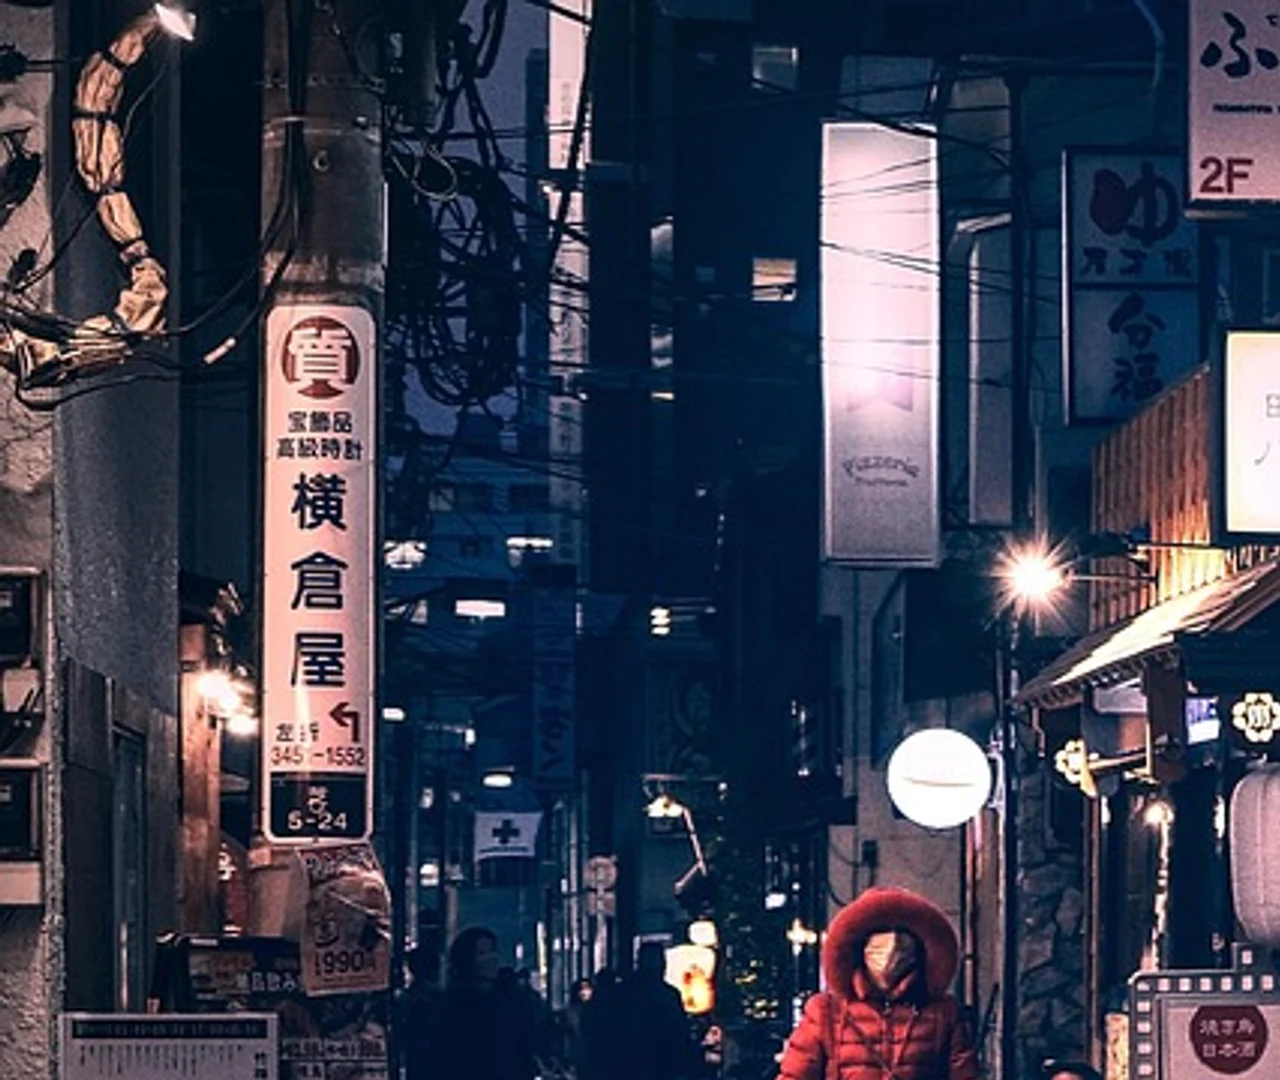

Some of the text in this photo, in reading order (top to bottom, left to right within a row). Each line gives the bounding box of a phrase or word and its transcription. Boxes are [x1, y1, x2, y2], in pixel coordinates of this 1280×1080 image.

[1199, 156, 1255, 194] 2F
[285, 318, 356, 400] 質
[287, 410, 353, 433] 宝飾品
[276, 437, 363, 461] 高級時計
[289, 472, 349, 688] 横倉屋
[1202, 1041, 1257, 1058] 日本酒
